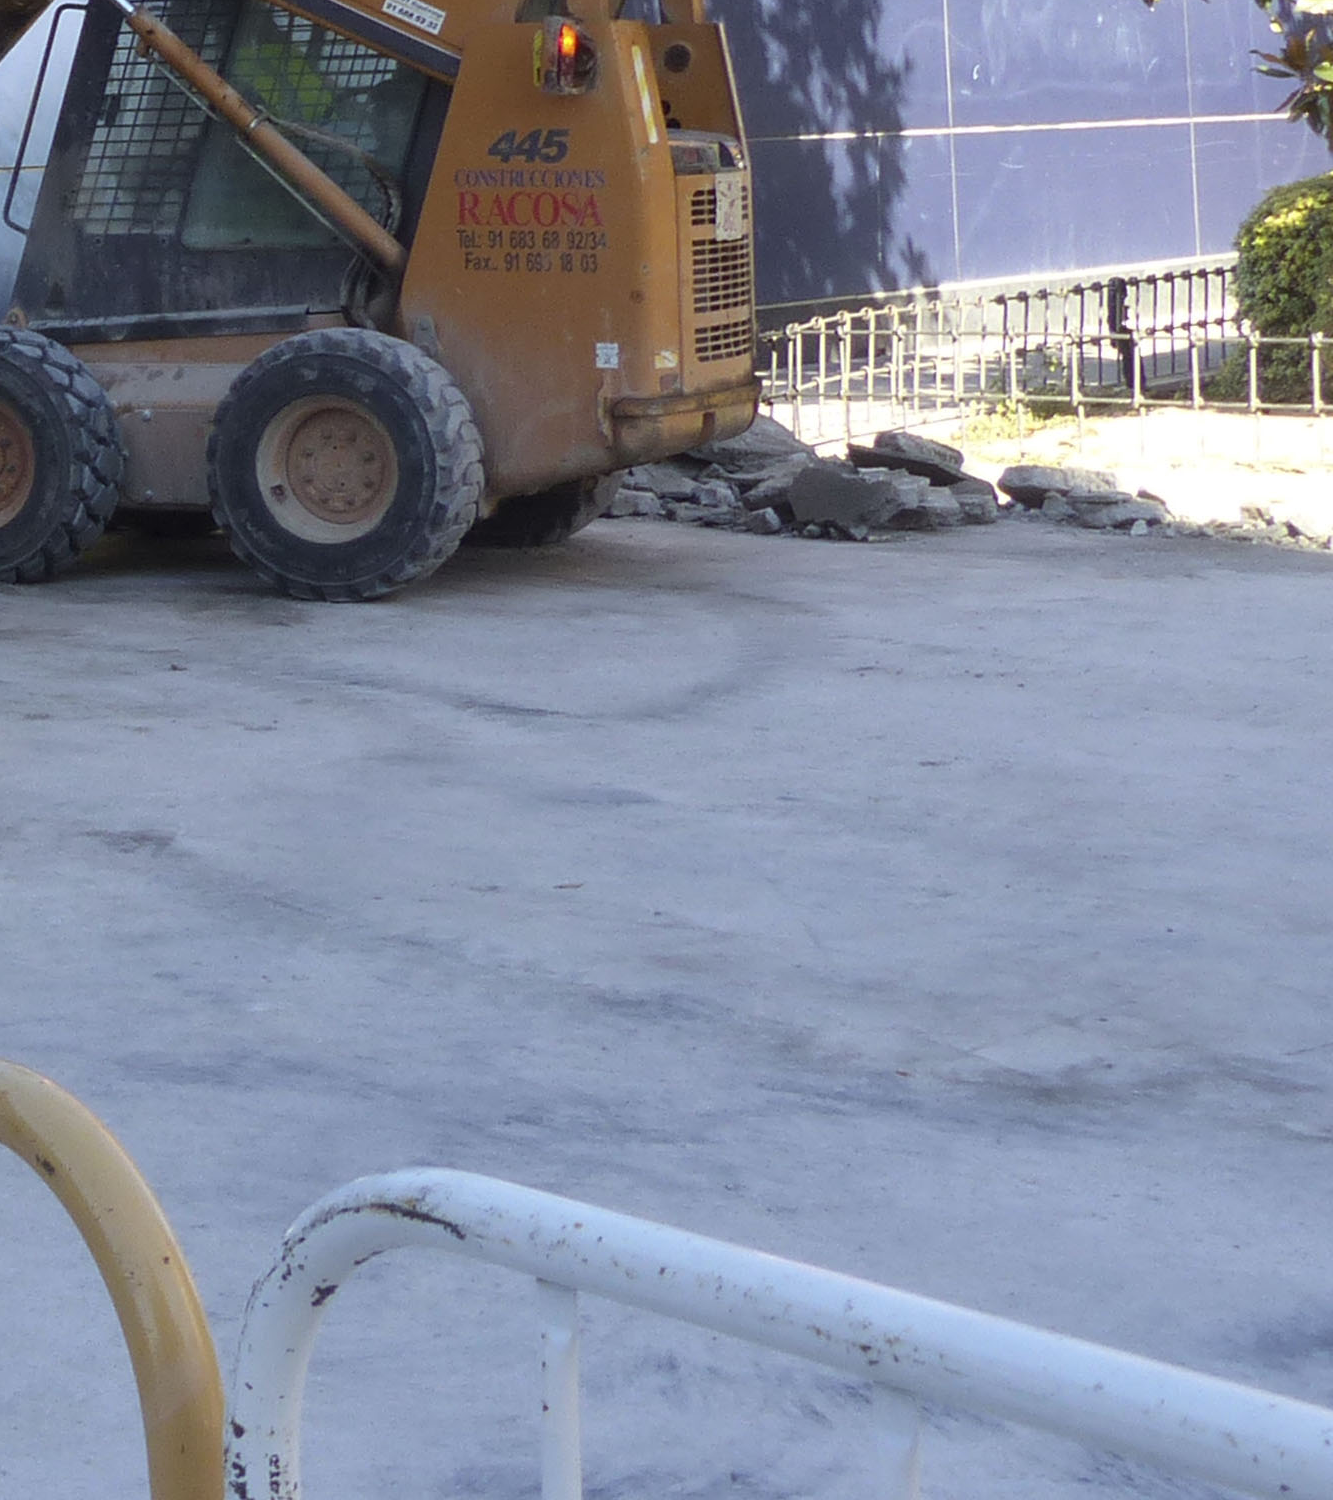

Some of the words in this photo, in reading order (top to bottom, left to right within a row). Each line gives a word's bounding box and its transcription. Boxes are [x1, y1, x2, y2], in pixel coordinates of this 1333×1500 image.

[487, 128, 571, 164] 445
[454, 168, 606, 189] CONSTRUCCIONES
[457, 191, 606, 228] RACOSA
[488, 230, 503, 250] 91
[510, 230, 535, 250] 683
[504, 252, 520, 273] 91
[580, 253, 599, 274] 03
